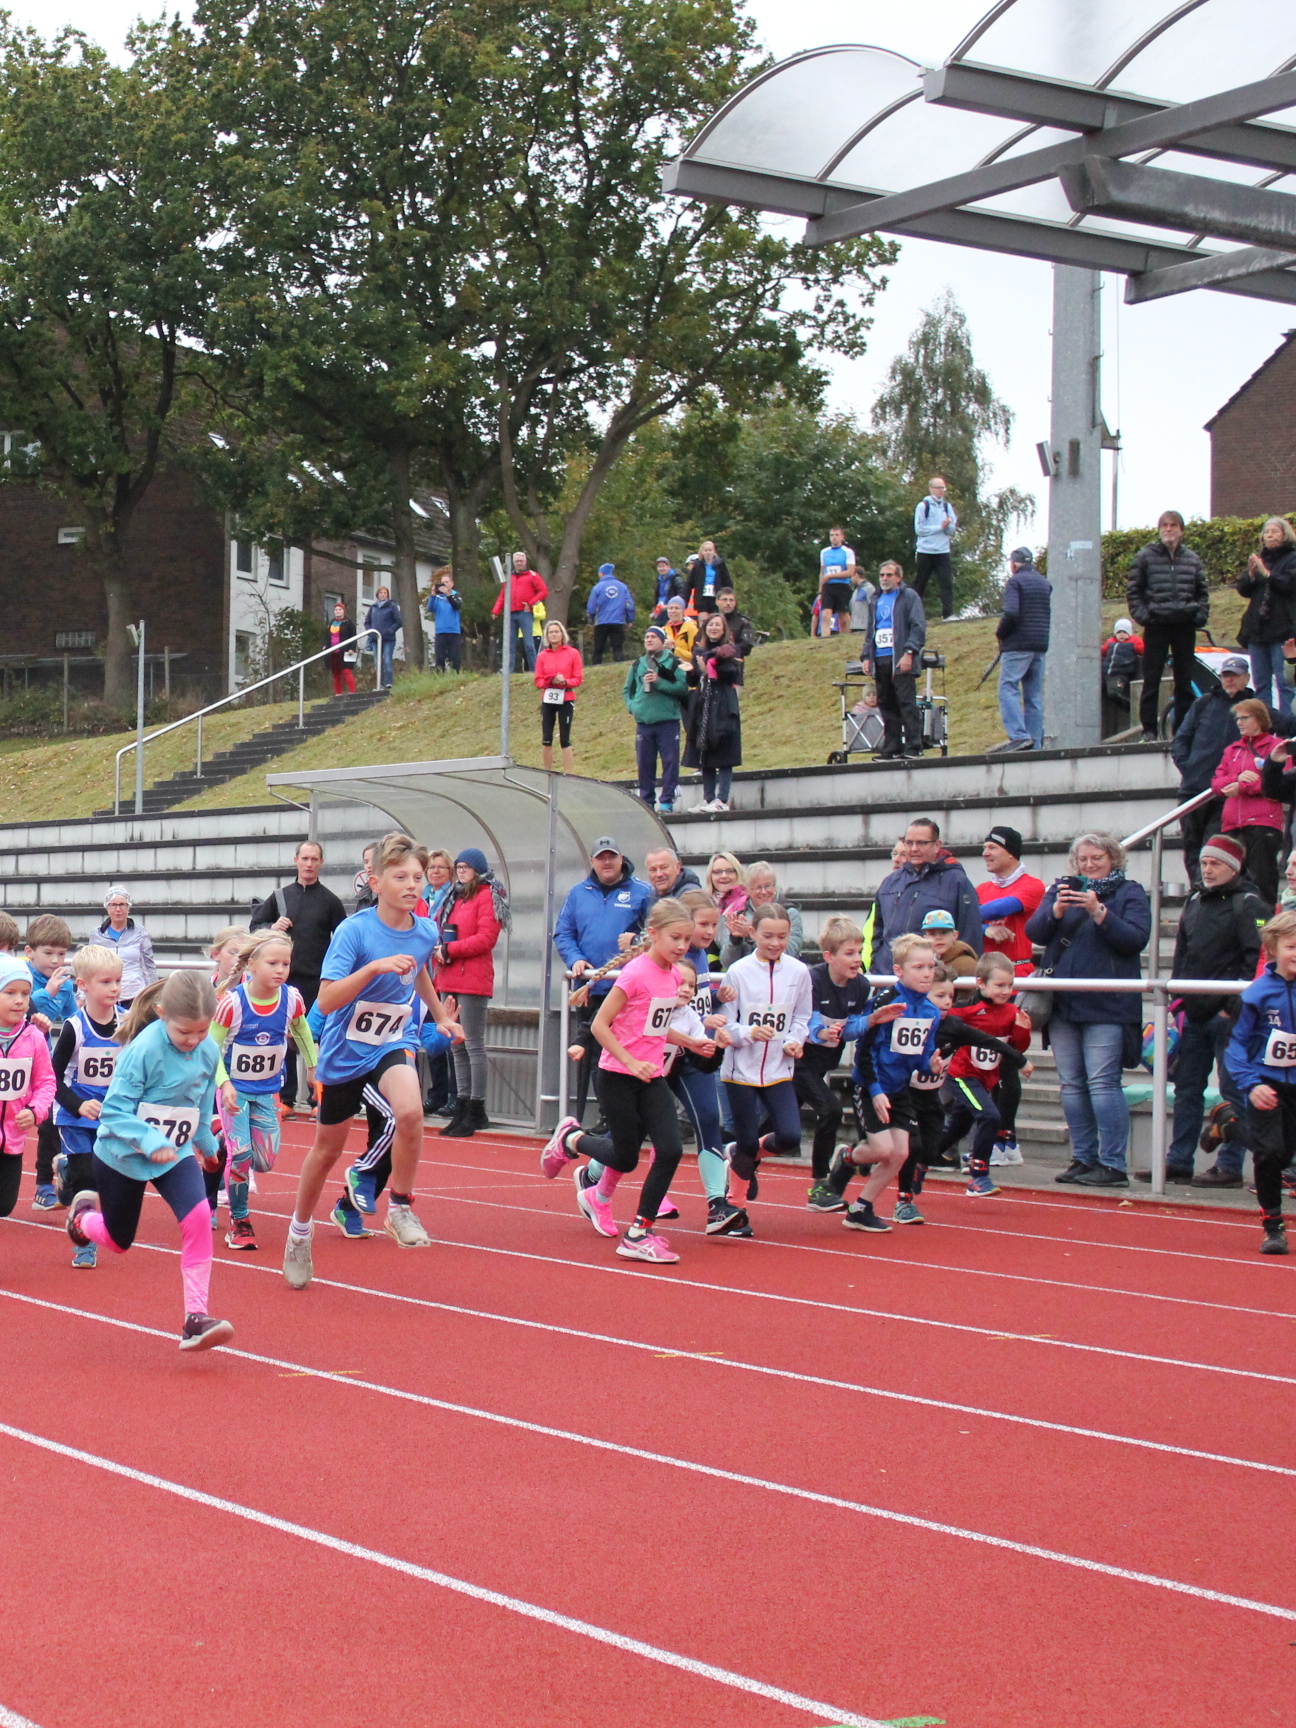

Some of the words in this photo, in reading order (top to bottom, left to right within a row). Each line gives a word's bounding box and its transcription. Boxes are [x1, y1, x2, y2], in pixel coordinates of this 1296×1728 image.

[877, 632, 894, 644] 357
[548, 692, 559, 701] 93
[355, 1011, 404, 1037] 674
[1268, 1015, 1282, 1027] 14
[236, 1053, 277, 1074] 681
